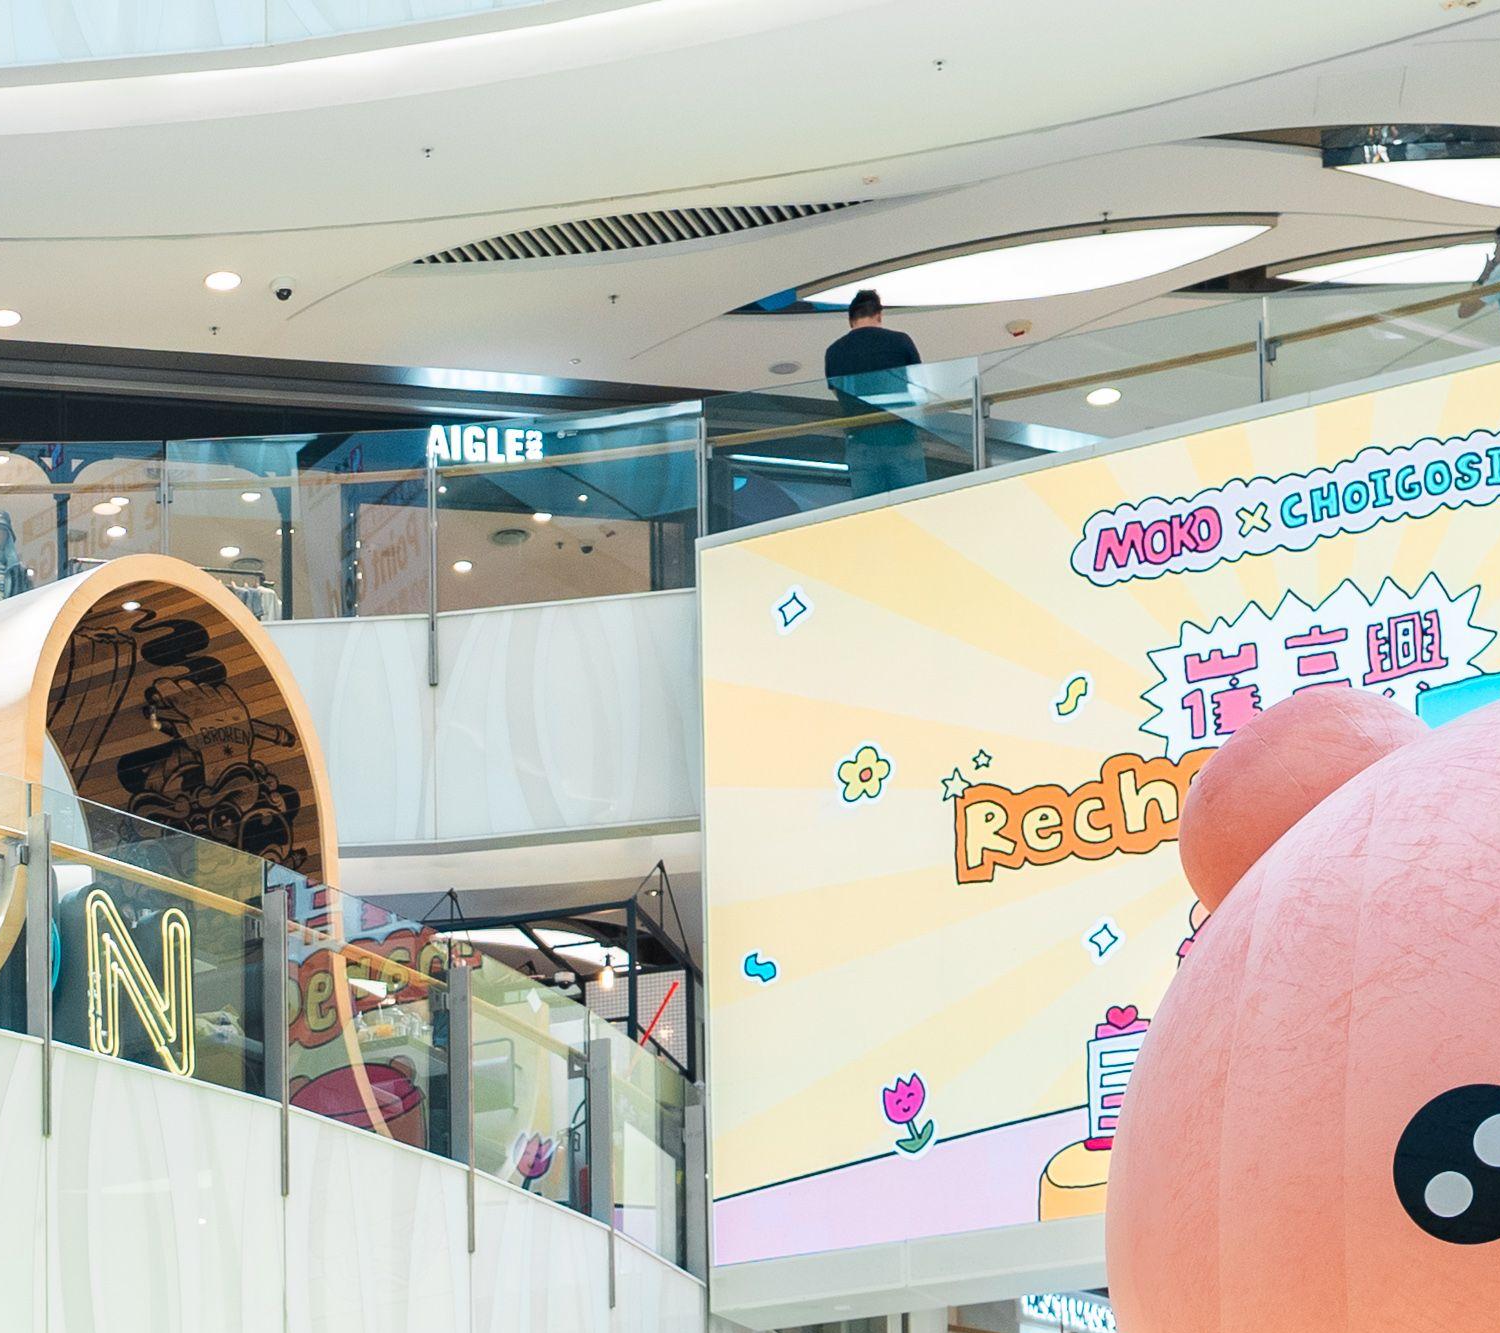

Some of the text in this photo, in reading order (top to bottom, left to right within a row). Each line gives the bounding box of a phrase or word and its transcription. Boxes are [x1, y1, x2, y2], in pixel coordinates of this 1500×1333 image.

[427, 424, 526, 463] AIGLE
[1093, 506, 1222, 571] MOKO
[962, 768, 1180, 870] Rech
